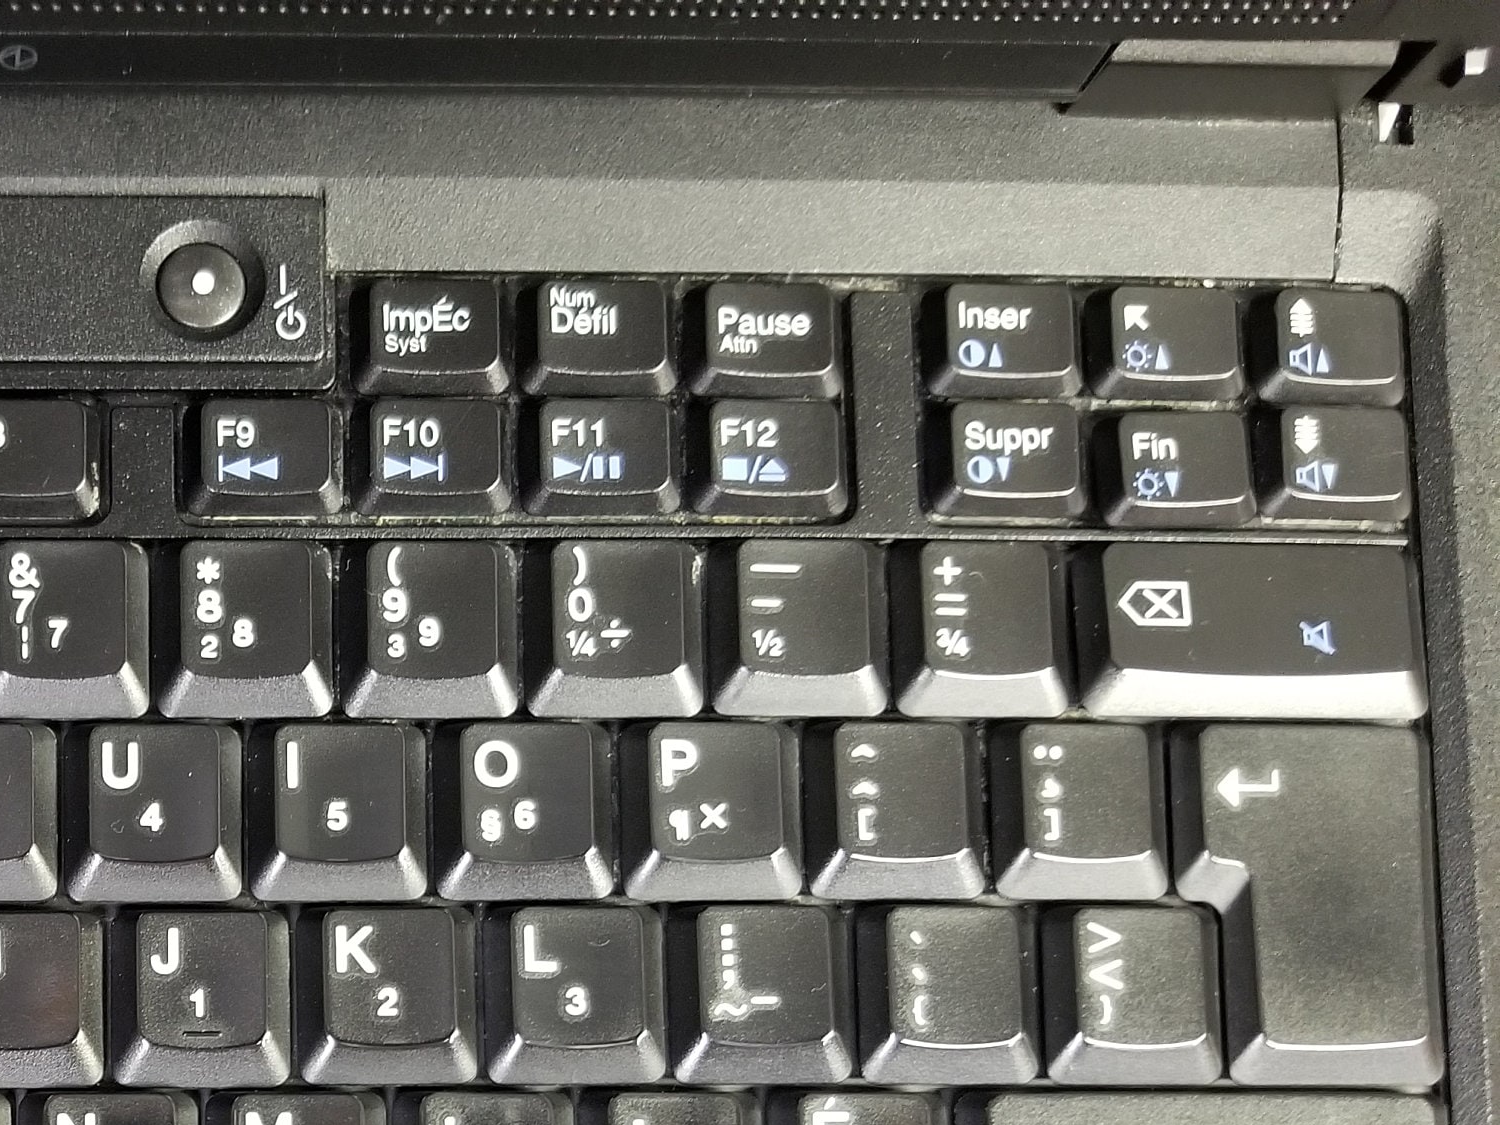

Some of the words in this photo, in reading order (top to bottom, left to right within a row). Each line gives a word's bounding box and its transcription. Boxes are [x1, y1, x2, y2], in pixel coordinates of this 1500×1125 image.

[549, 286, 596, 310] Num
[382, 295, 471, 335] ImpÉc
[550, 305, 617, 335] Défil
[717, 306, 811, 335] Pause
[958, 300, 1032, 330] Inser
[384, 333, 427, 356] Syst
[720, 336, 757, 353] Attn
[217, 418, 255, 448] F9
[383, 417, 440, 448] F10
[551, 417, 604, 447] F11
[720, 417, 777, 448] F12
[964, 420, 1054, 457] Suppr
[1131, 431, 1178, 460] Fin
[11, 590, 36, 624] 7
[196, 589, 223, 623] 8
[382, 587, 408, 623] 9
[567, 587, 594, 622] 0
[48, 618, 69, 649] 7
[232, 618, 255, 648] 8
[418, 617, 441, 647] 9
[101, 741, 139, 790] U
[473, 739, 520, 788] O
[659, 738, 699, 787] P
[139, 802, 164, 832] 4
[326, 800, 348, 831] 5
[513, 800, 536, 830] 6
[150, 927, 180, 975] J
[335, 925, 377, 974] K
[523, 924, 560, 974] L
[190, 988, 204, 1017] 1
[376, 986, 399, 1017] 2
[565, 986, 588, 1016] 3
